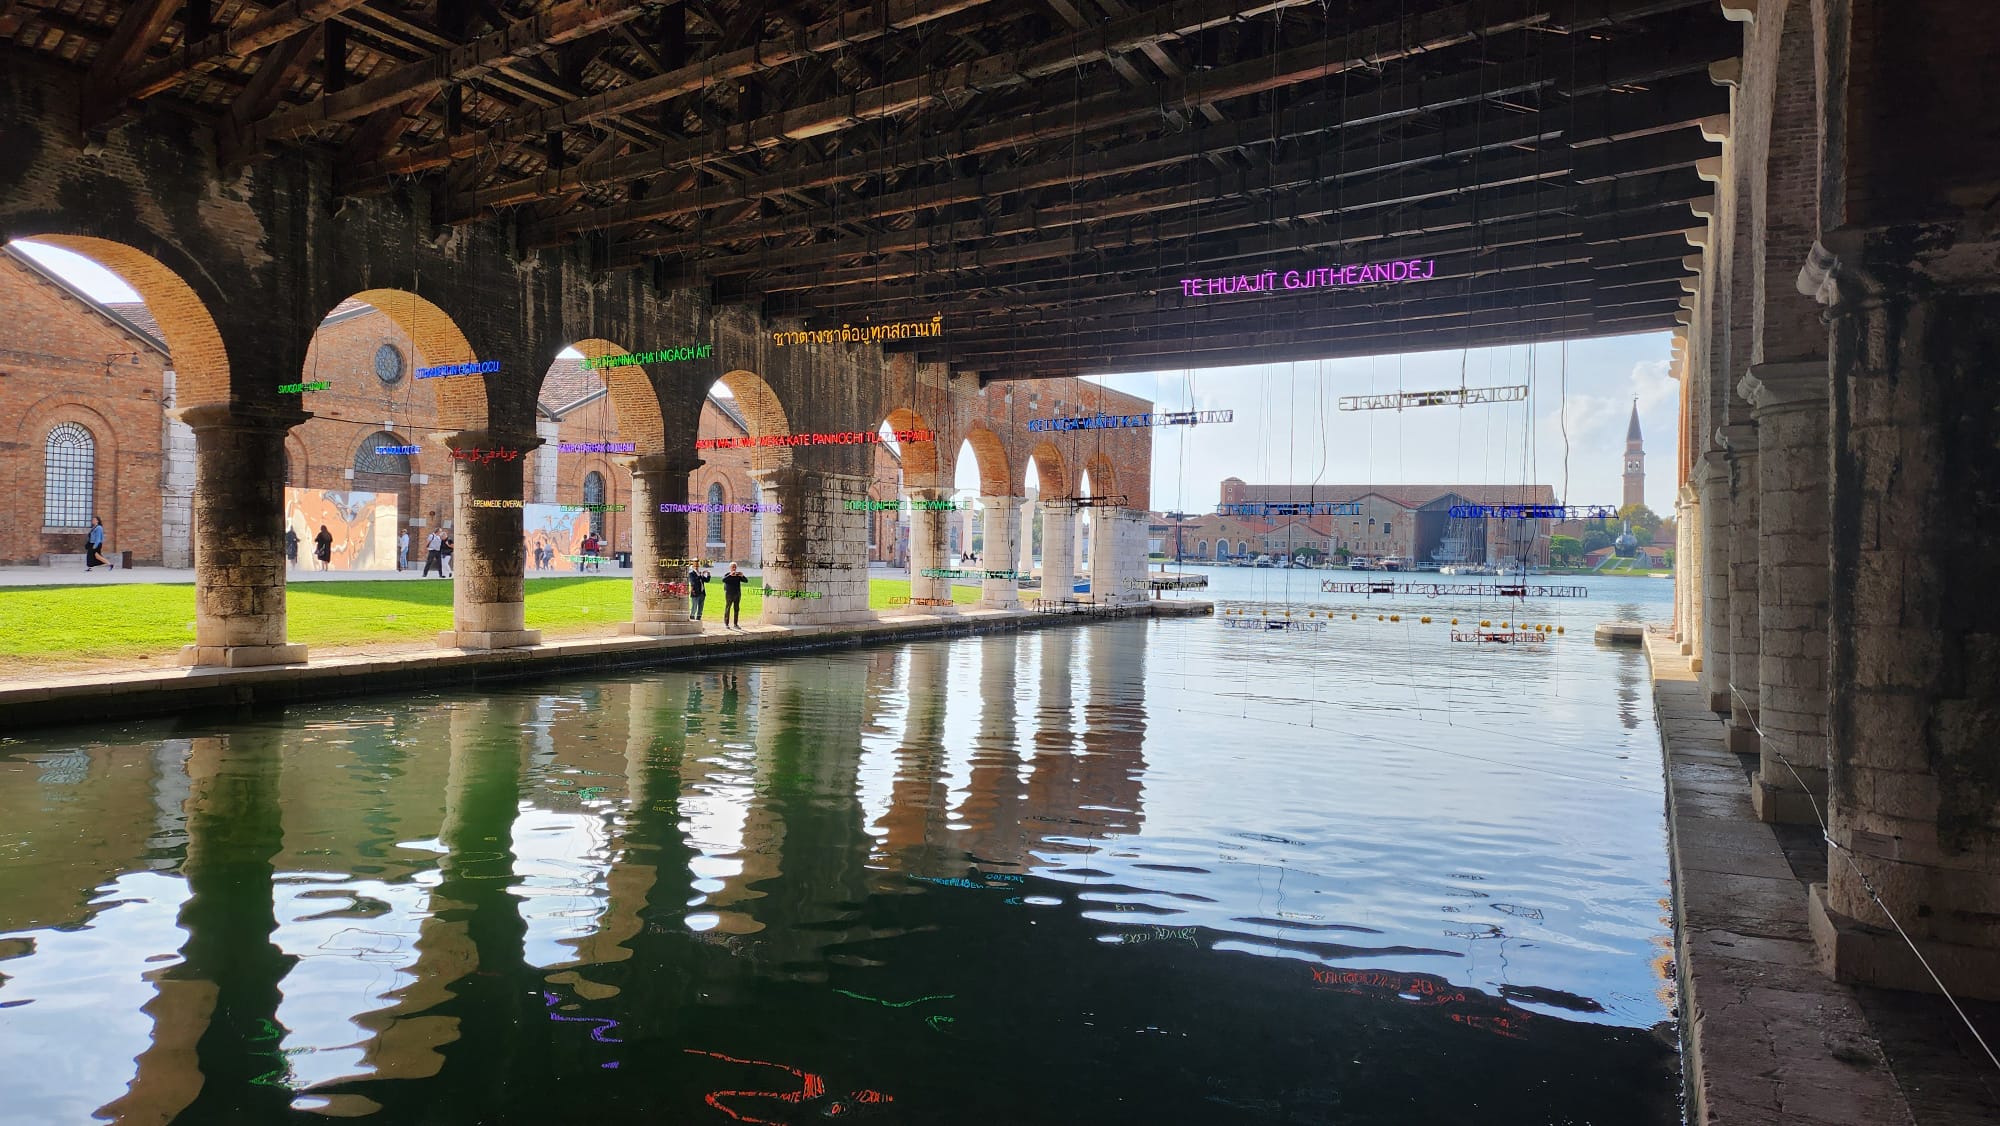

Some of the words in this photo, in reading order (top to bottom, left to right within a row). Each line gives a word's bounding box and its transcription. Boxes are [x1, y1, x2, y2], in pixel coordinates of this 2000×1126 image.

[1180, 278, 1202, 297] TE
[1208, 272, 1278, 296] HUAJIT
[1284, 260, 1435, 289] GJITHEANDEJ
[773, 310, 943, 346] ชาวต่างชาติอยู่ทุกสถานที่
[812, 431, 863, 445] PANNOCHI
